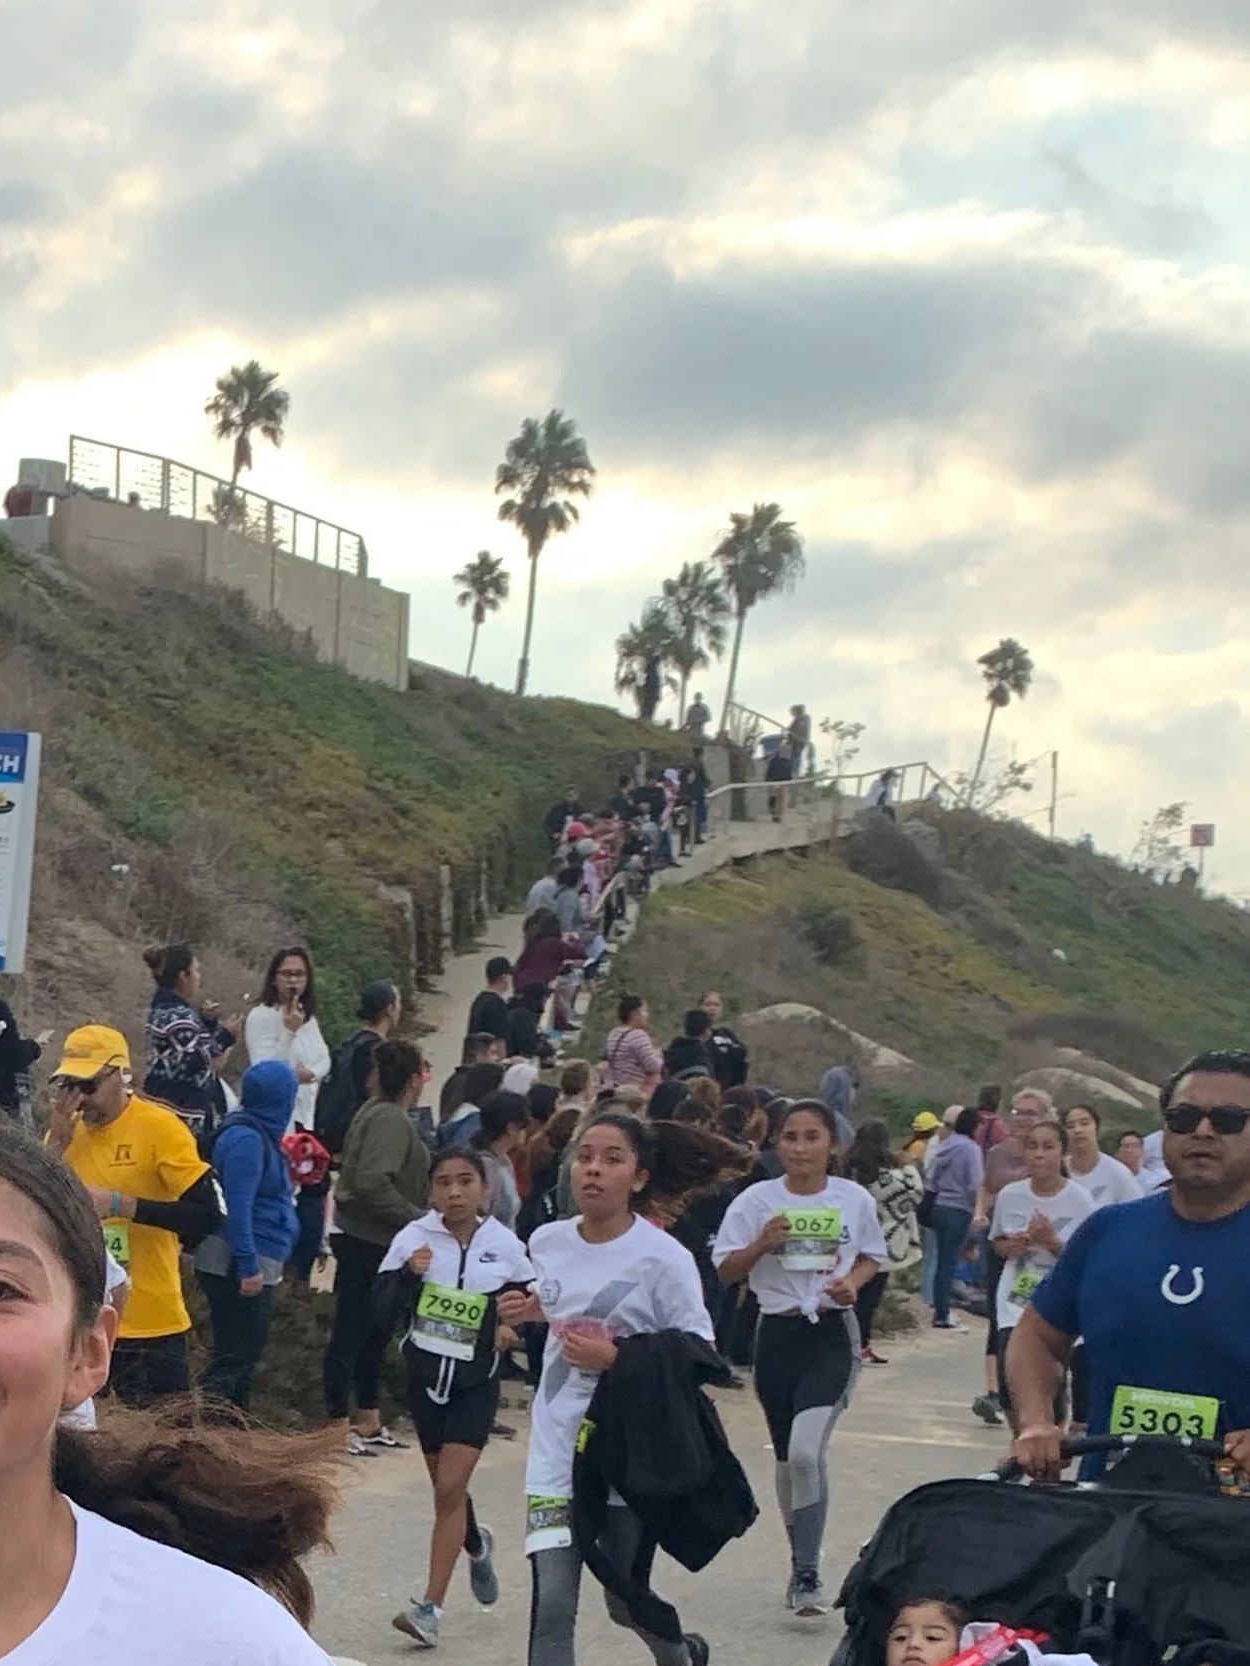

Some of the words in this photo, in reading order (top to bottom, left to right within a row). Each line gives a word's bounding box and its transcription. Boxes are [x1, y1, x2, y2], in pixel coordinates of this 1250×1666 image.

[789, 1218, 835, 1232] 067
[426, 1294, 480, 1320] 7990
[1118, 1405, 1204, 1438] 5303
